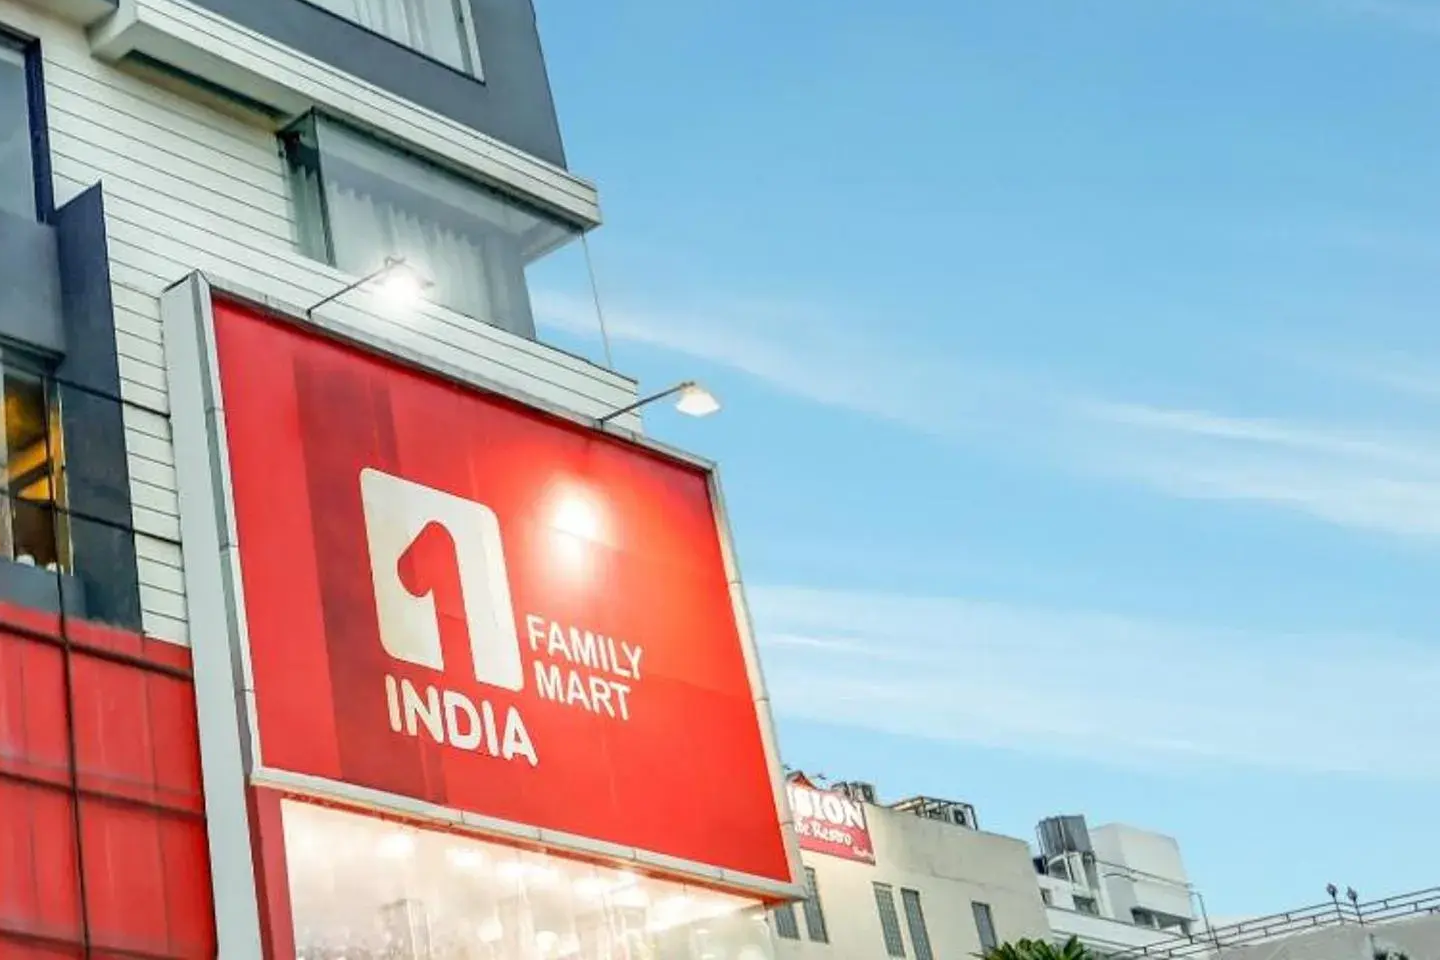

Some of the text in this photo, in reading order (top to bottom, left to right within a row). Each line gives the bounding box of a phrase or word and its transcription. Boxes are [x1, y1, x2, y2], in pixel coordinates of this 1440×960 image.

[526, 614, 643, 681] FAMILY
[384, 673, 539, 767] INDIA
[533, 660, 631, 721] MART
